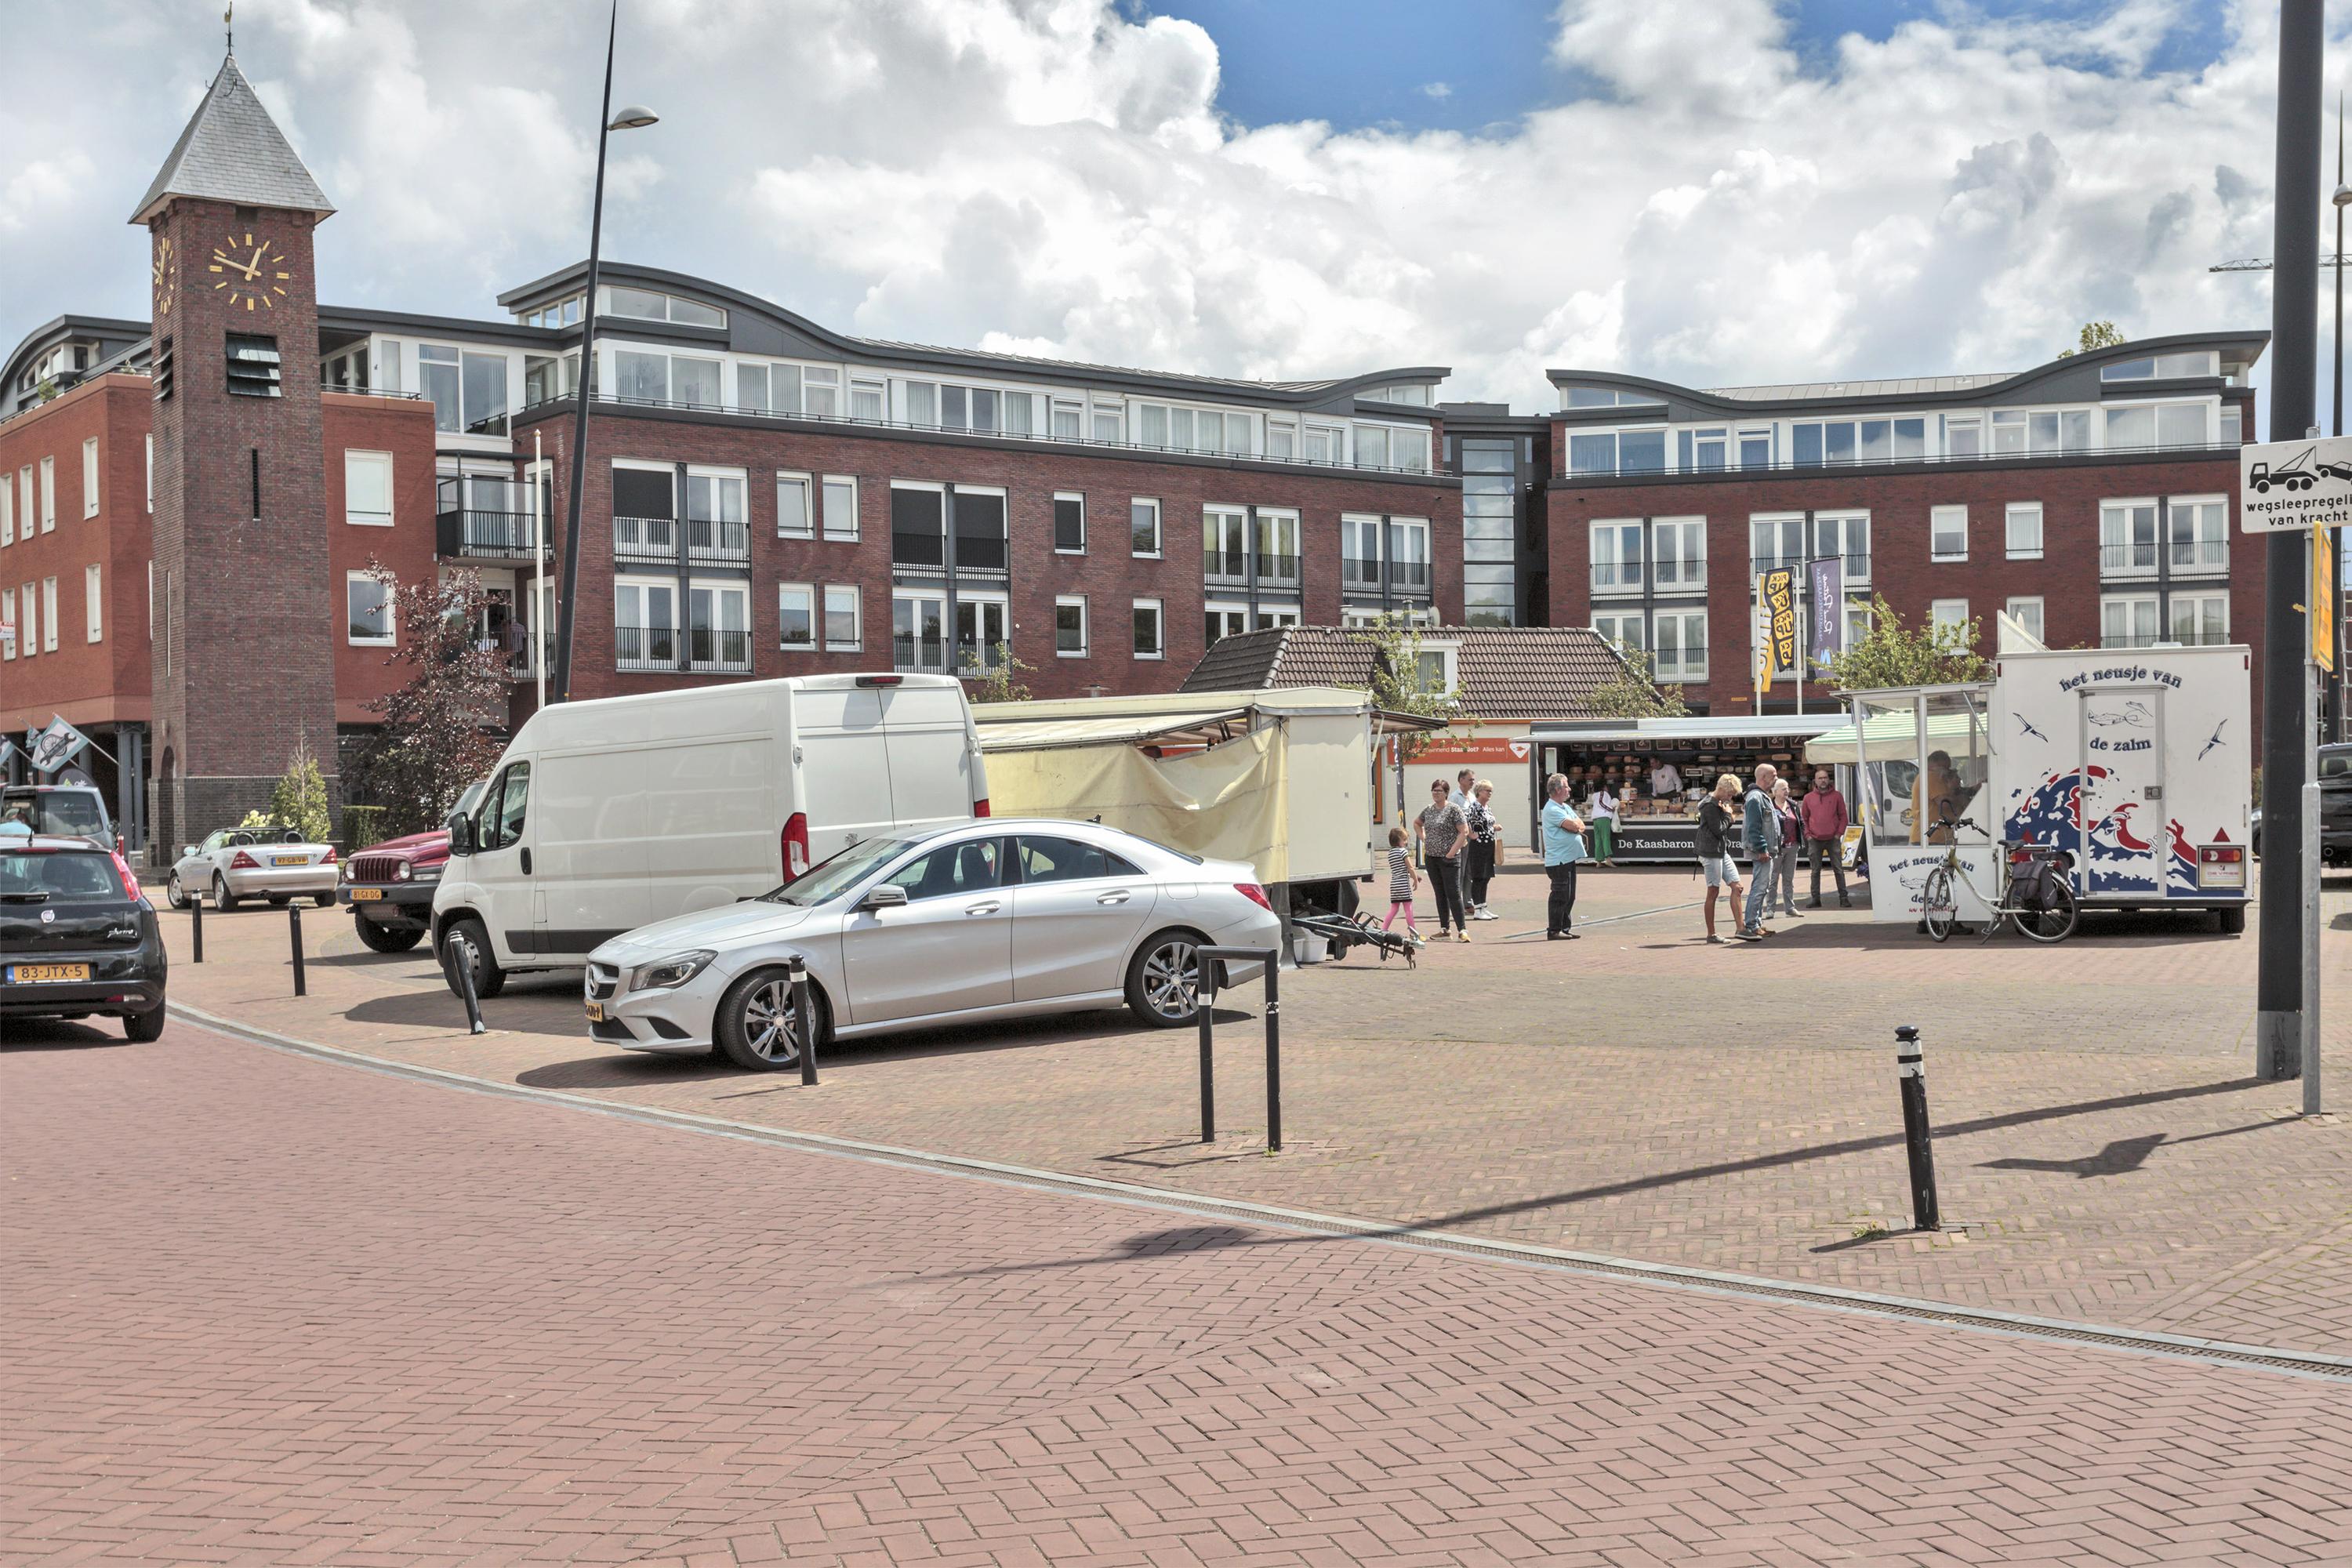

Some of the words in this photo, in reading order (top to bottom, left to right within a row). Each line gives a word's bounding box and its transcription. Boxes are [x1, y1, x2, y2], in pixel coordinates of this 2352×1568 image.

[2246, 493, 2352, 514] wegsleepregeli
[2269, 515, 2294, 526] van
[2300, 510, 2348, 524] kracht
[2059, 670, 2089, 692] het
[2092, 665, 2147, 681] neusje
[2152, 669, 2183, 689] van
[2089, 737, 2108, 750] de
[2114, 738, 2152, 751] zalm
[1617, 839, 1632, 848] De
[1635, 839, 1695, 848] Kaasbaron
[1889, 859, 1909, 873] het
[1911, 894, 1925, 903] de
[21, 965, 82, 978] 83-JTX-5
